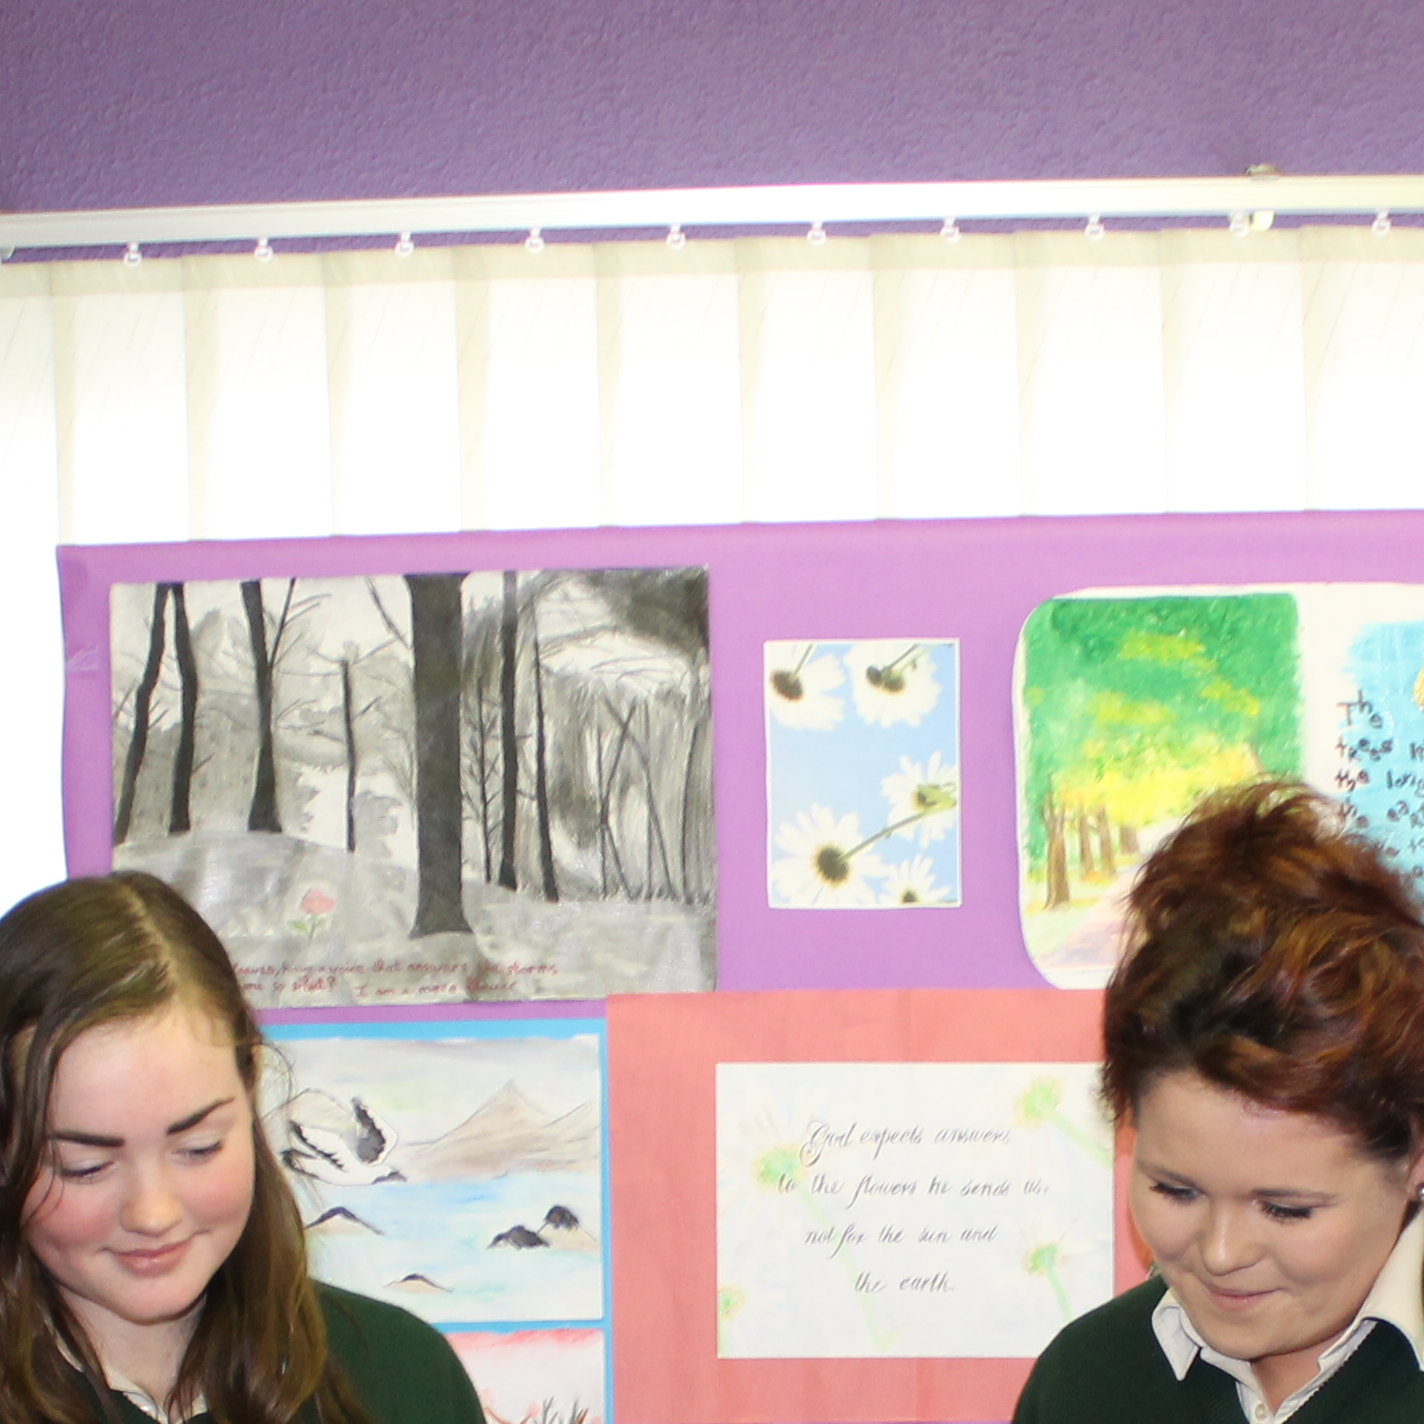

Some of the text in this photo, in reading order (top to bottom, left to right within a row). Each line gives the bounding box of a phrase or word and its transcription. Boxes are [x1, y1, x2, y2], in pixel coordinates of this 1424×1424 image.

[799, 1119, 858, 1167] God
[859, 1124, 924, 1161] expects
[776, 1173, 799, 1195] to
[810, 1172, 844, 1196] the
[844, 1173, 919, 1211] flowers
[927, 1174, 953, 1195] he
[959, 1178, 1012, 1197] sends
[804, 1222, 999, 1260] not for the sun and
[853, 1271, 888, 1294] the
